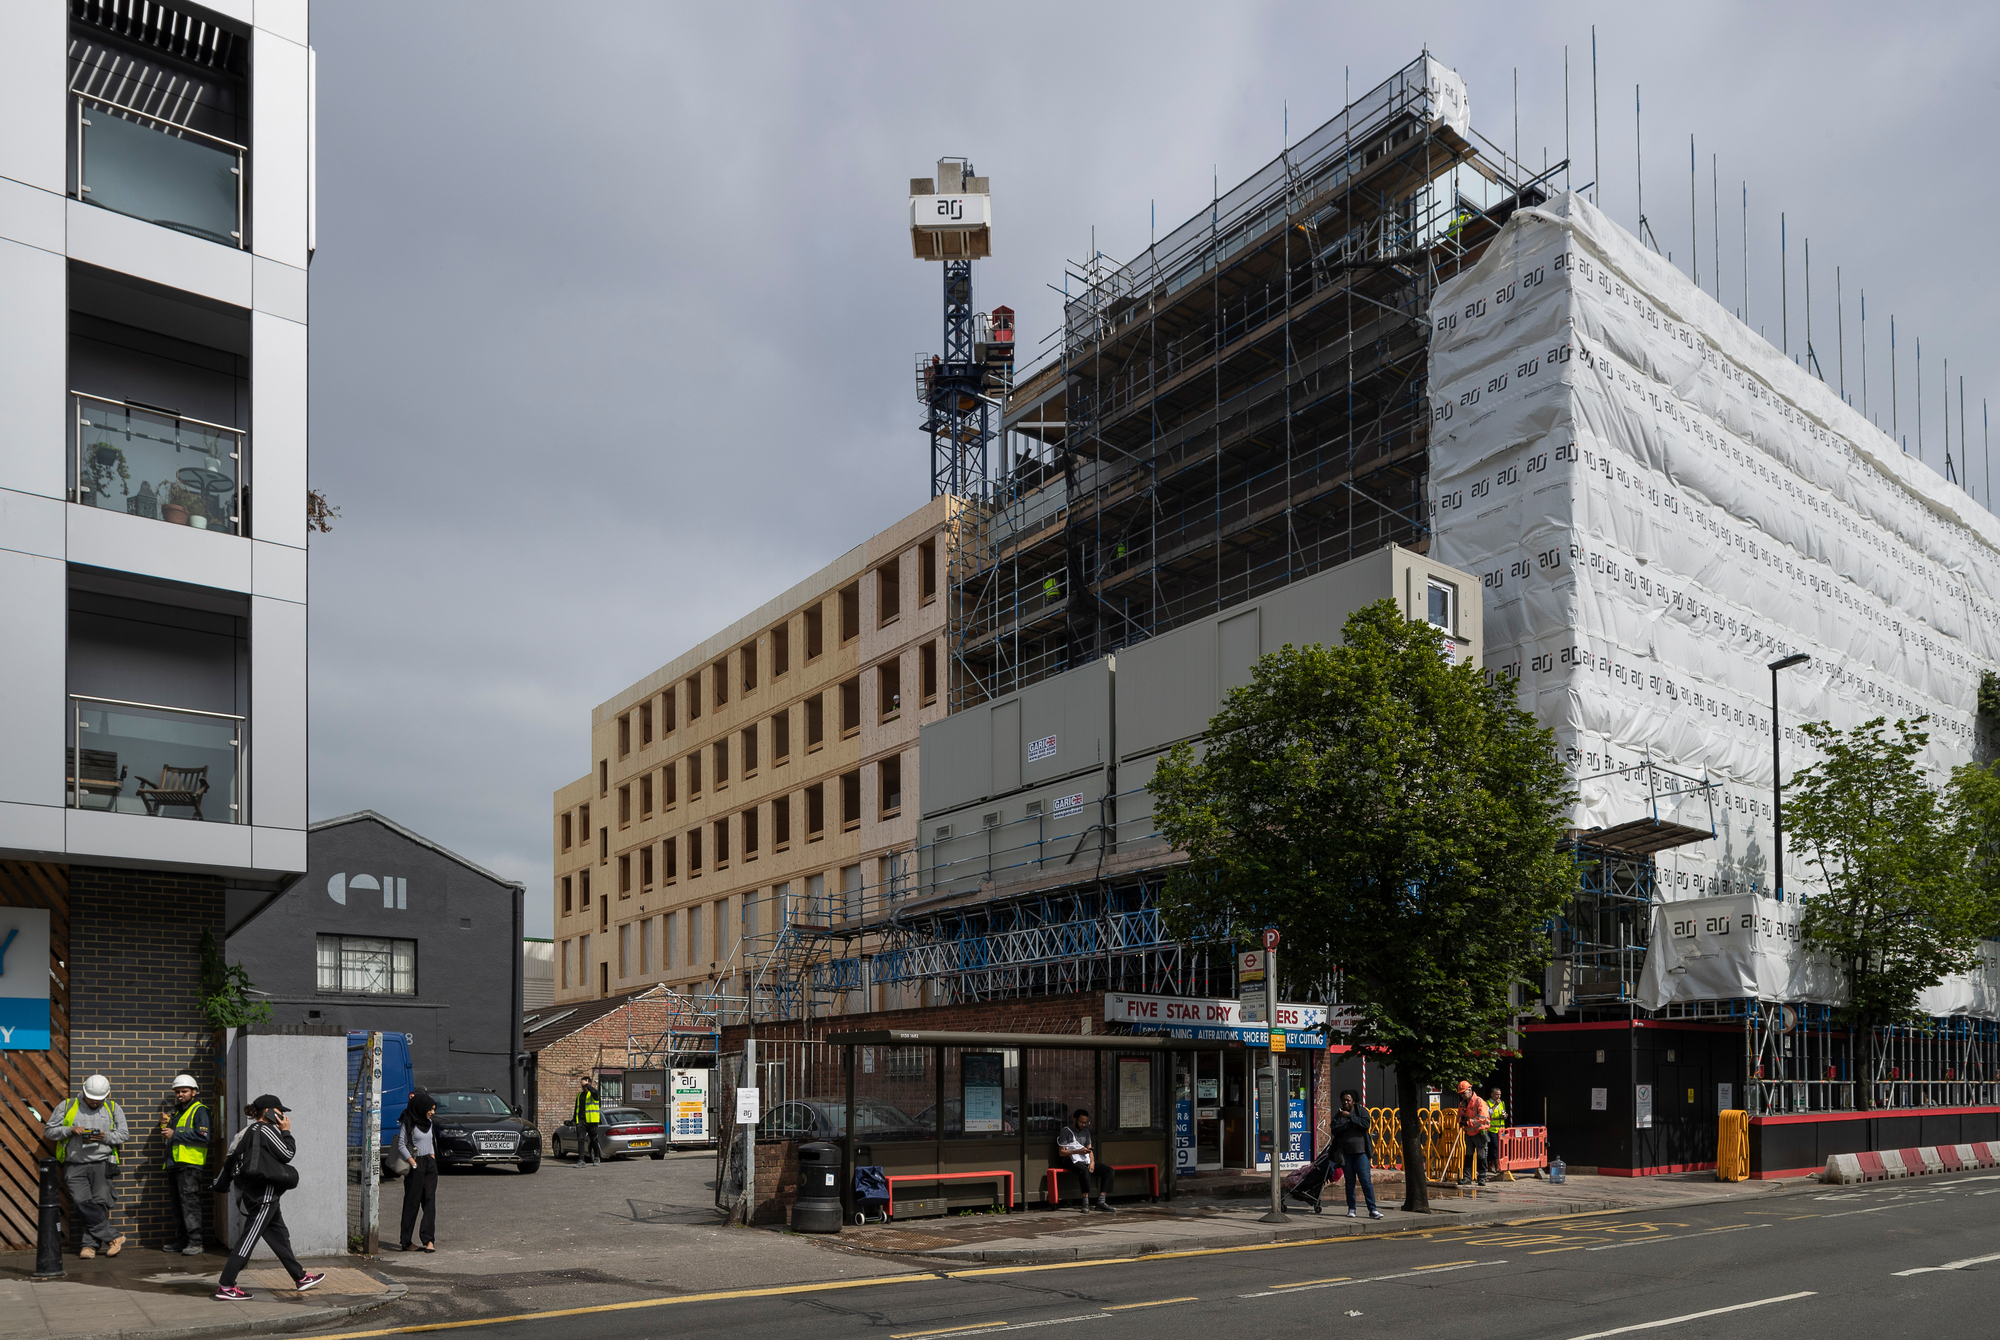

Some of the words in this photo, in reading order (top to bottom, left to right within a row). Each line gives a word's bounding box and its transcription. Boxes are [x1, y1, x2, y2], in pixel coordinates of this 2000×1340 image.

[937, 200, 962, 220] arj
[1438, 312, 1457, 334] arj
[1466, 298, 1486, 318] arj
[1497, 282, 1515, 304] arj
[1524, 266, 1544, 288] arj
[1579, 258, 1593, 282] arj
[1598, 271, 1611, 295] arj
[1616, 283, 1629, 305] arj
[1633, 295, 1644, 318] arj
[1647, 307, 1658, 329] arj
[1663, 319, 1676, 340] arj
[1680, 328, 1693, 349] arj
[1697, 338, 1706, 360] arj
[1436, 401, 1453, 421] arj
[1460, 387, 1480, 406] arj
[1488, 373, 1508, 393] arj
[1515, 358, 1538, 378] arj
[1547, 344, 1572, 364] arj
[1442, 491, 1462, 510] arj
[1472, 478, 1489, 497] arj
[1497, 465, 1518, 485] arj
[1527, 453, 1547, 473] arj
[1556, 443, 1578, 463] arj
[1485, 569, 1503, 588] arj
[1511, 559, 1530, 579] arj
[1538, 548, 1560, 569] arj
[1532, 653, 1552, 673] arj
[1030, 738, 1049, 752] GARIC
[1055, 796, 1076, 809] GARIC
[1677, 871, 1688, 890] arj
[1693, 874, 1704, 892] arj
[1675, 920, 1696, 939] arj
[1707, 916, 1729, 935] arj
[1266, 932, 1275, 947] P
[1127, 1001, 1158, 1017] FIVE
[1167, 1003, 1200, 1020] STAR
[1206, 1006, 1232, 1021] DRY
[1198, 1029, 1238, 1040] ALTERATIONS
[1243, 1031, 1259, 1042] SHOE
[1286, 1033, 1297, 1043] KEY
[1299, 1034, 1324, 1045] CUTTING
[682, 1077, 696, 1088] arj
